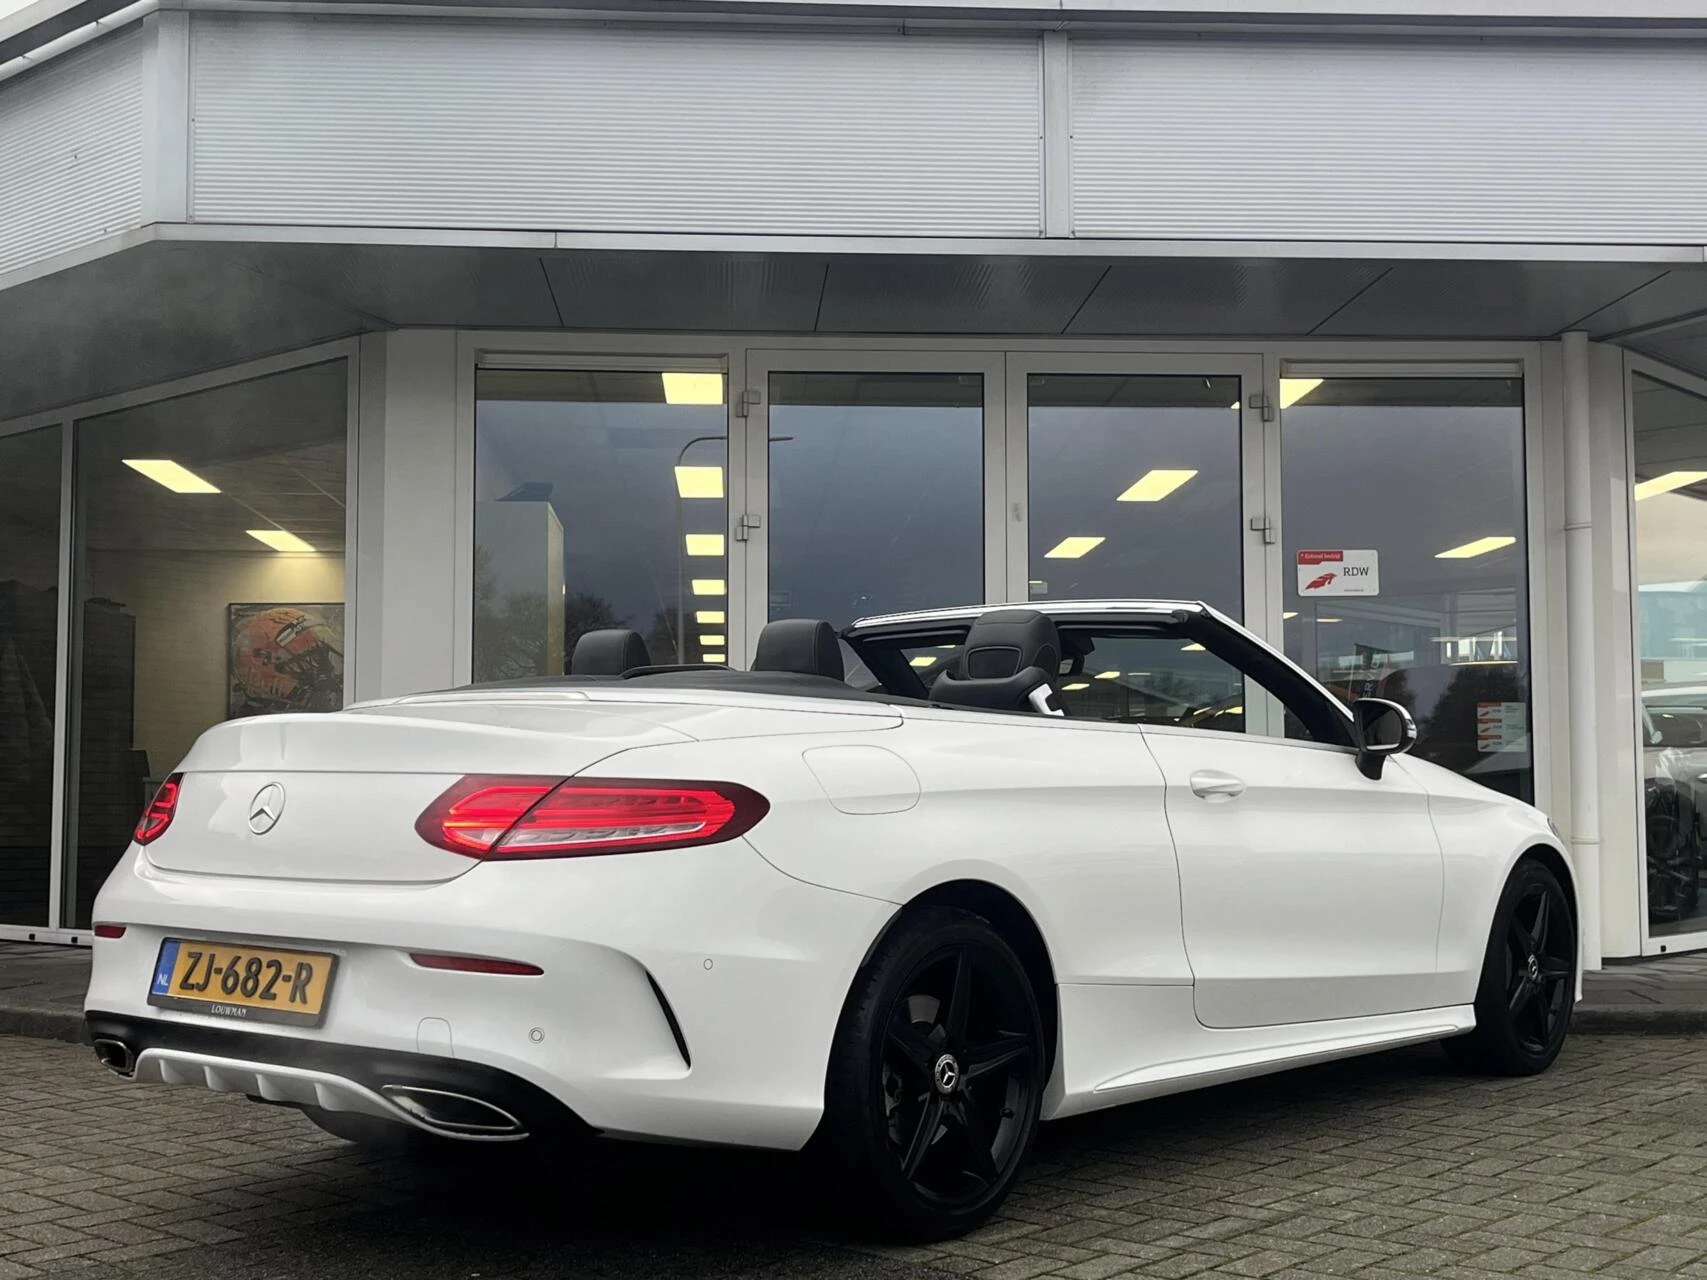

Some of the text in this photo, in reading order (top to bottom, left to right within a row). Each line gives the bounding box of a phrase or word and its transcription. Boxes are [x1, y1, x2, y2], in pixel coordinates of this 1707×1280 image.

[1343, 566, 1369, 577] RDW
[156, 974, 169, 986] NL
[179, 951, 314, 1005] ZJ-682-R
[210, 1004, 248, 1017] LOUWMAN
